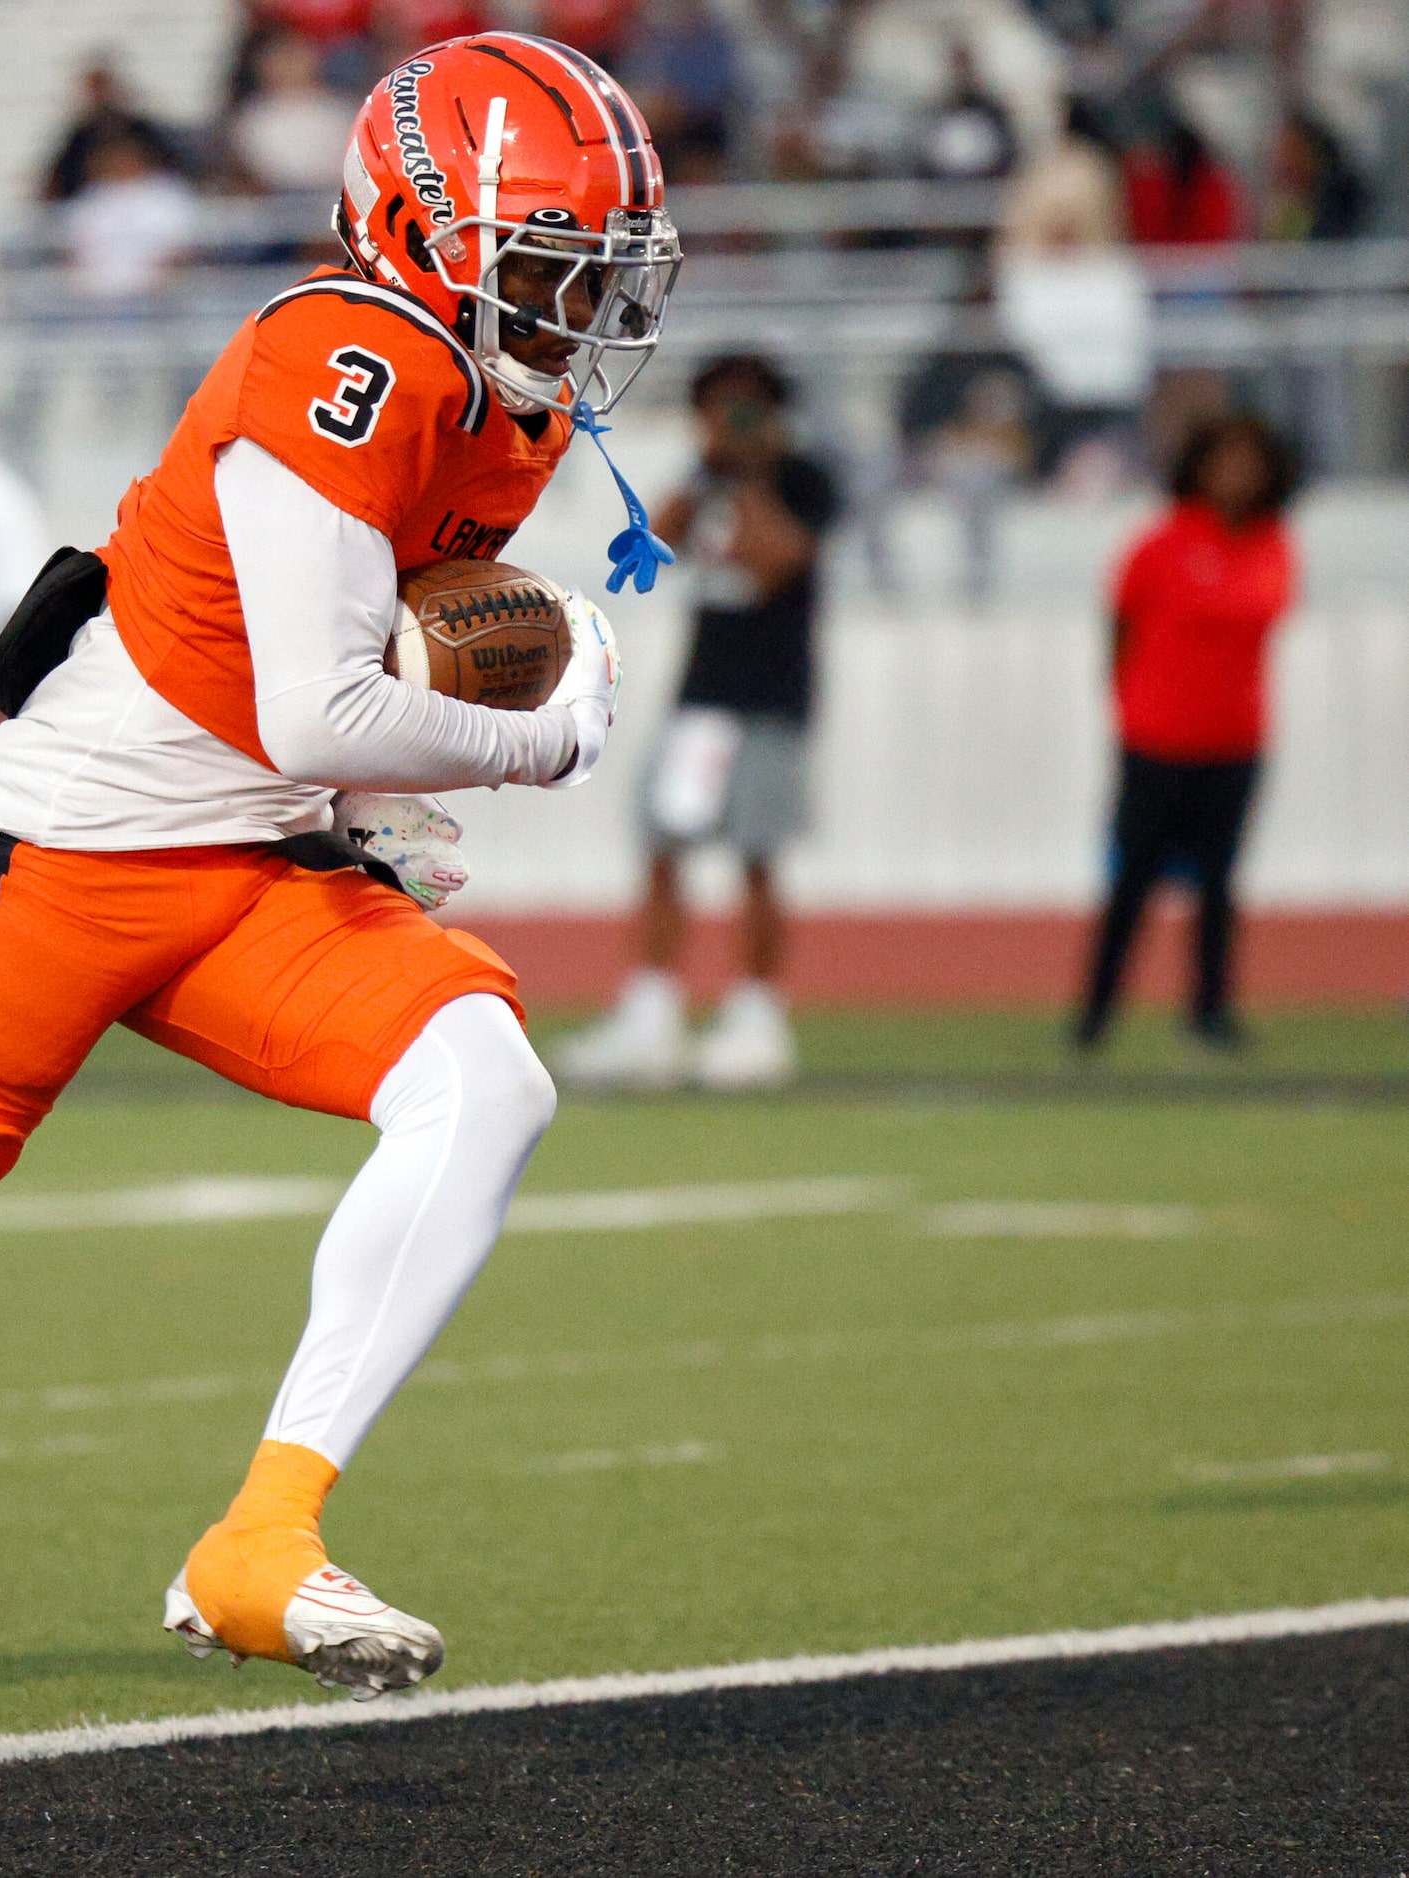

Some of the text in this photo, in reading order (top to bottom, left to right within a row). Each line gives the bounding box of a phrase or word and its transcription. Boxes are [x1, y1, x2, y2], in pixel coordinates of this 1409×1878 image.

[384, 60, 454, 226] Lancaster
[307, 344, 397, 449] 3
[472, 644, 549, 670] Wilson
